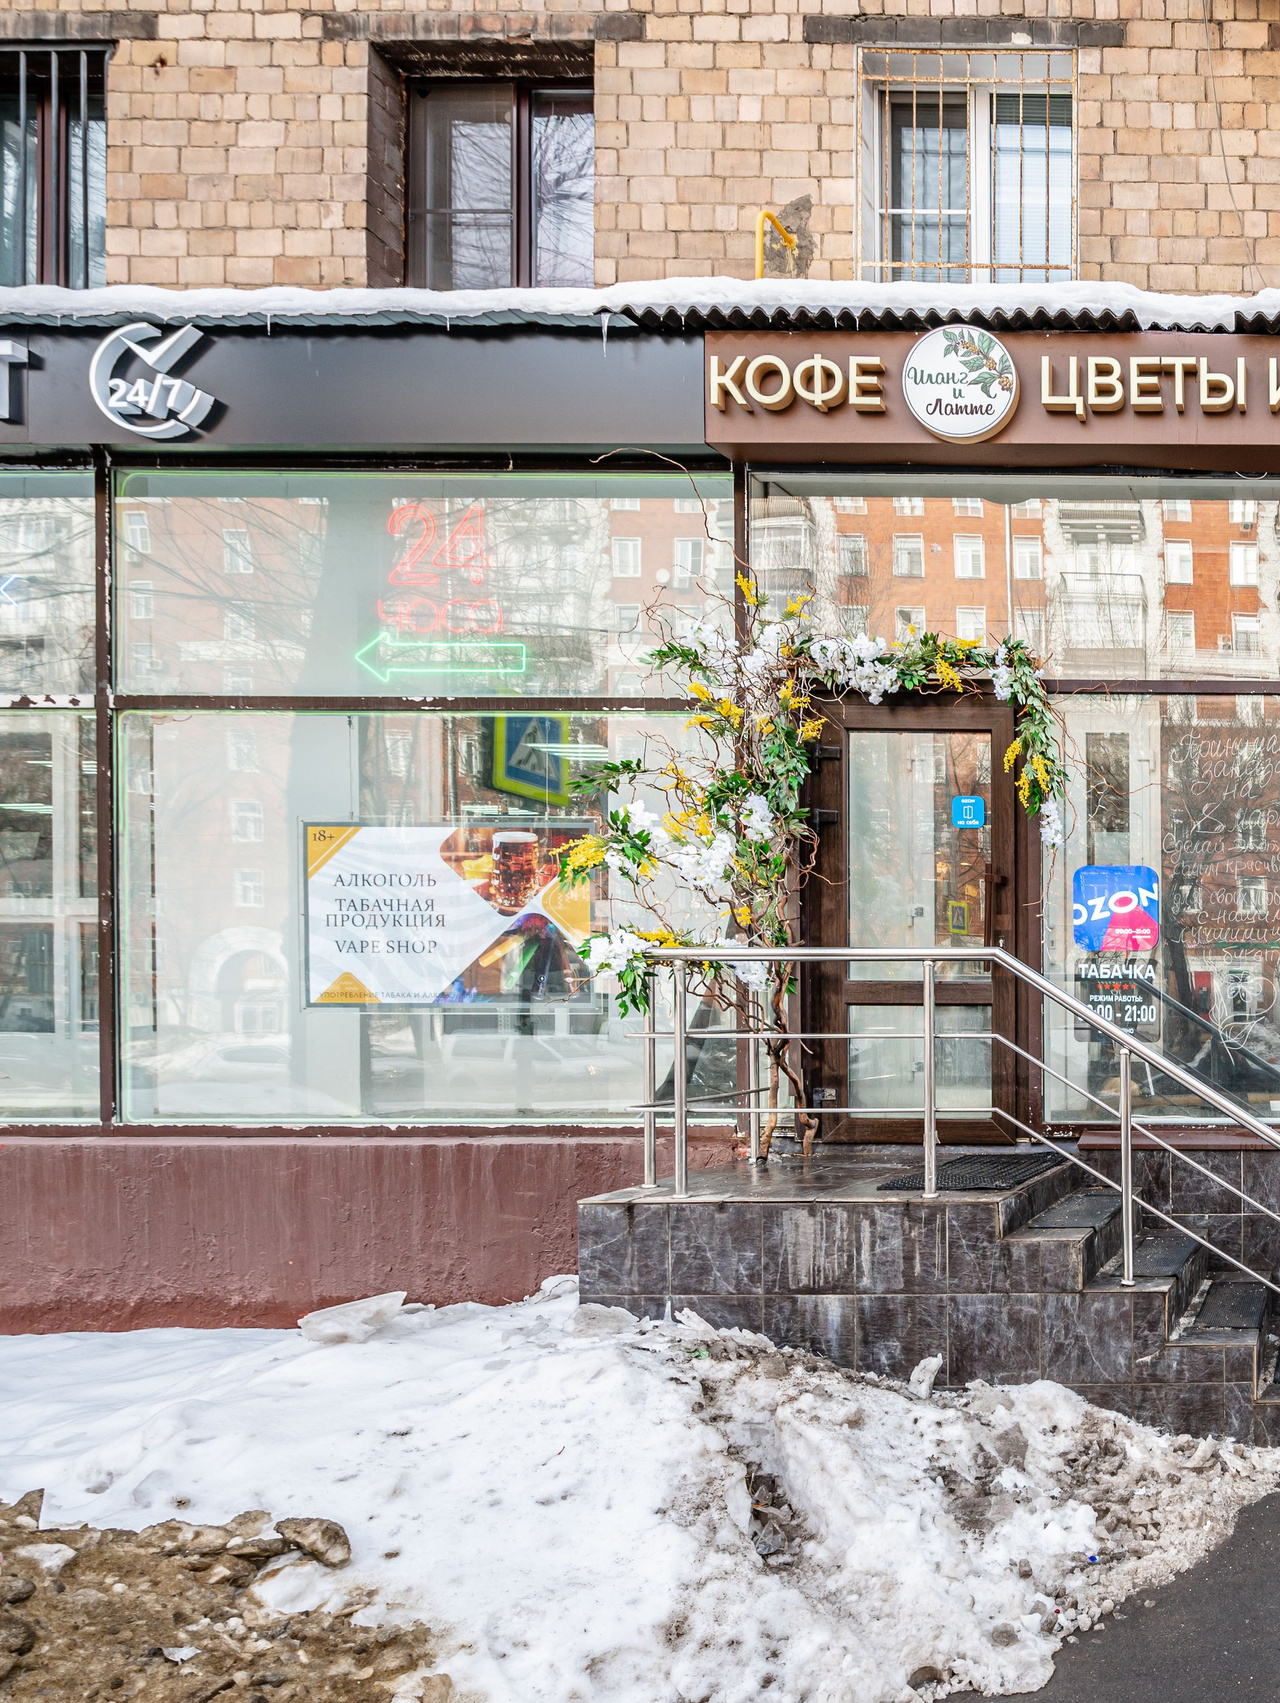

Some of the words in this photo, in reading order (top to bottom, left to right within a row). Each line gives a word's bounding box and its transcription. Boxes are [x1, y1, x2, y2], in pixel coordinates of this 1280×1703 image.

[709, 353, 885, 412] КОФЕ
[907, 366, 969, 386] Иланг
[108, 373, 183, 413] 24/7
[952, 387, 965, 399] и
[1041, 355, 1247, 420] ЦВЕТЫ
[925, 398, 996, 416] Латте
[388, 505, 490, 586] 24
[1223, 782, 1259, 801] на
[313, 829, 335, 842] 18+
[333, 873, 438, 887] АЛКОГОЛЬ
[335, 898, 435, 912] ТАБАЧНАЯ
[1073, 882, 1159, 926] OZON
[326, 914, 446, 930] ПРОДУКЦИЯ
[335, 940, 381, 954] VAPE
[386, 940, 437, 954] SHOP
[1078, 963, 1156, 979] ТАБАЧКА
[1124, 1005, 1157, 1022] 21:00
